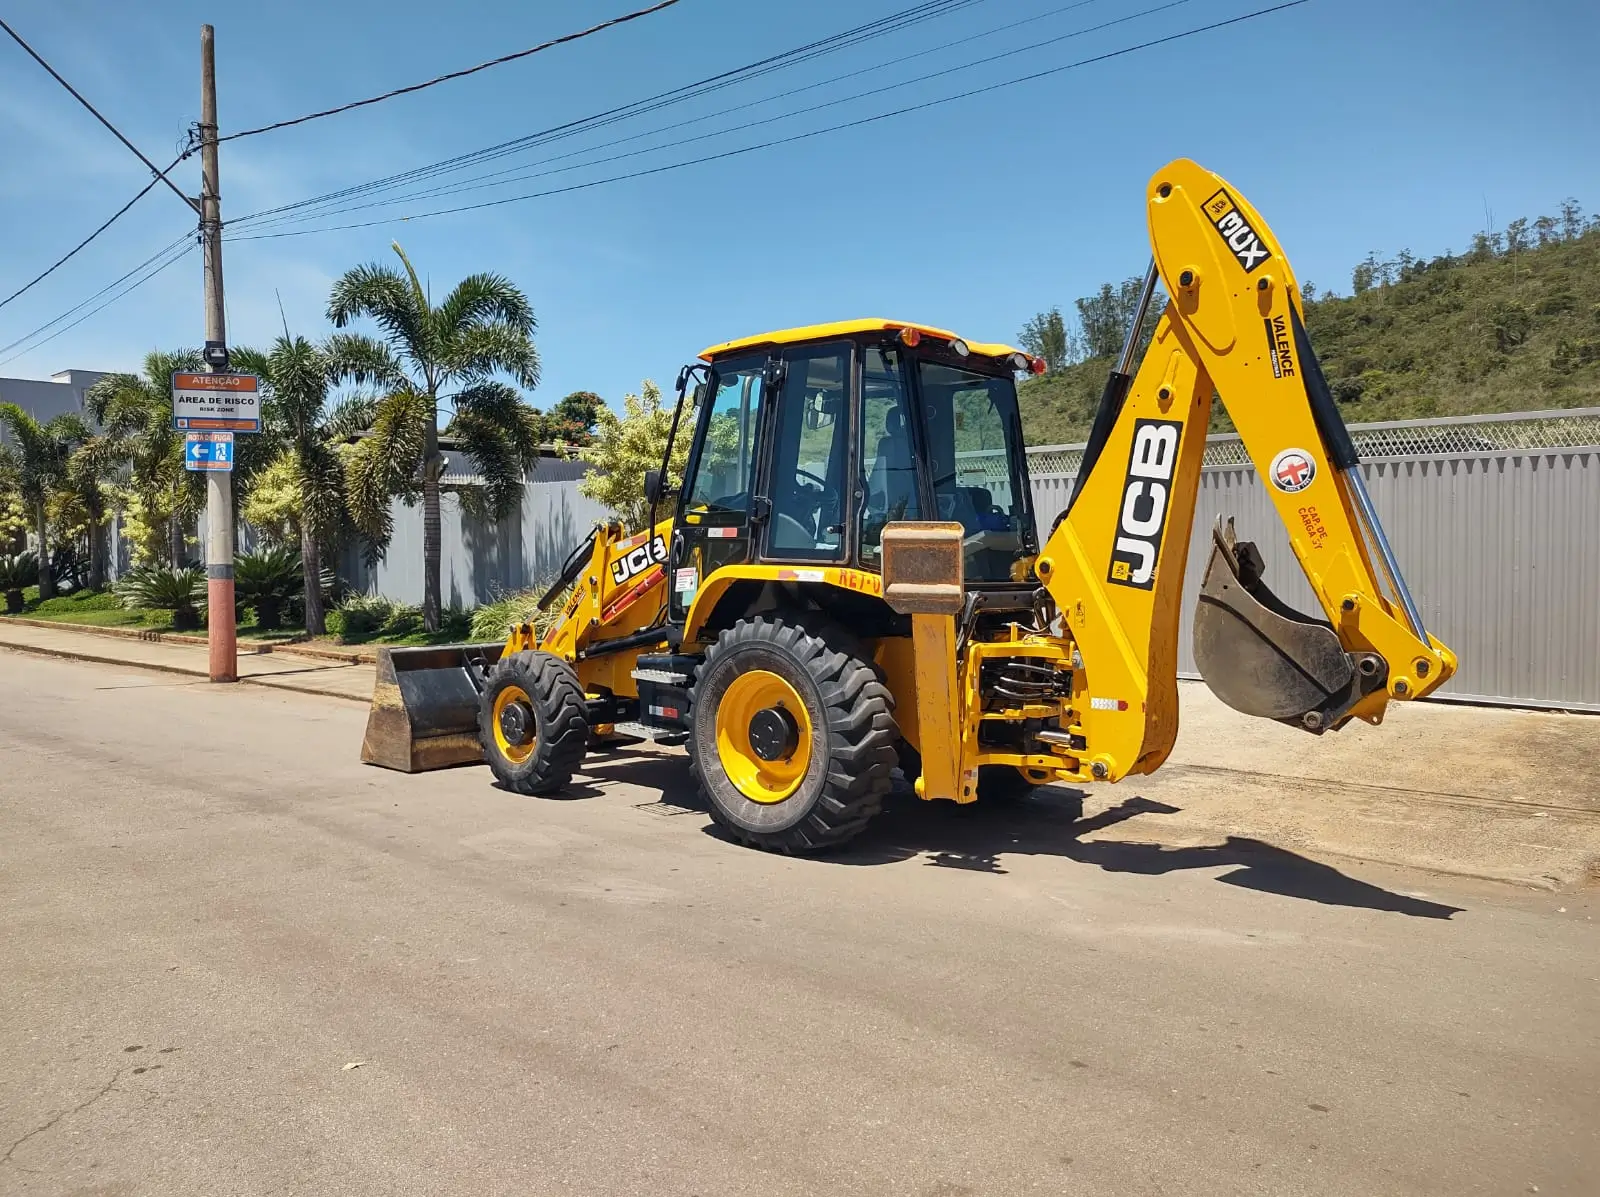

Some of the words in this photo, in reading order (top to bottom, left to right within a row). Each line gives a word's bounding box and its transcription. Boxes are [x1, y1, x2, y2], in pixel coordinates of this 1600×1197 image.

[1272, 314, 1295, 378] VALENCE
[192, 376, 240, 386] ATENÇÃO
[178, 395, 206, 404] ÁREA
[1115, 424, 1178, 584] JCB
[1298, 507, 1317, 538] CARGA
[1316, 526, 1328, 540] DE
[613, 536, 667, 583] JCB
